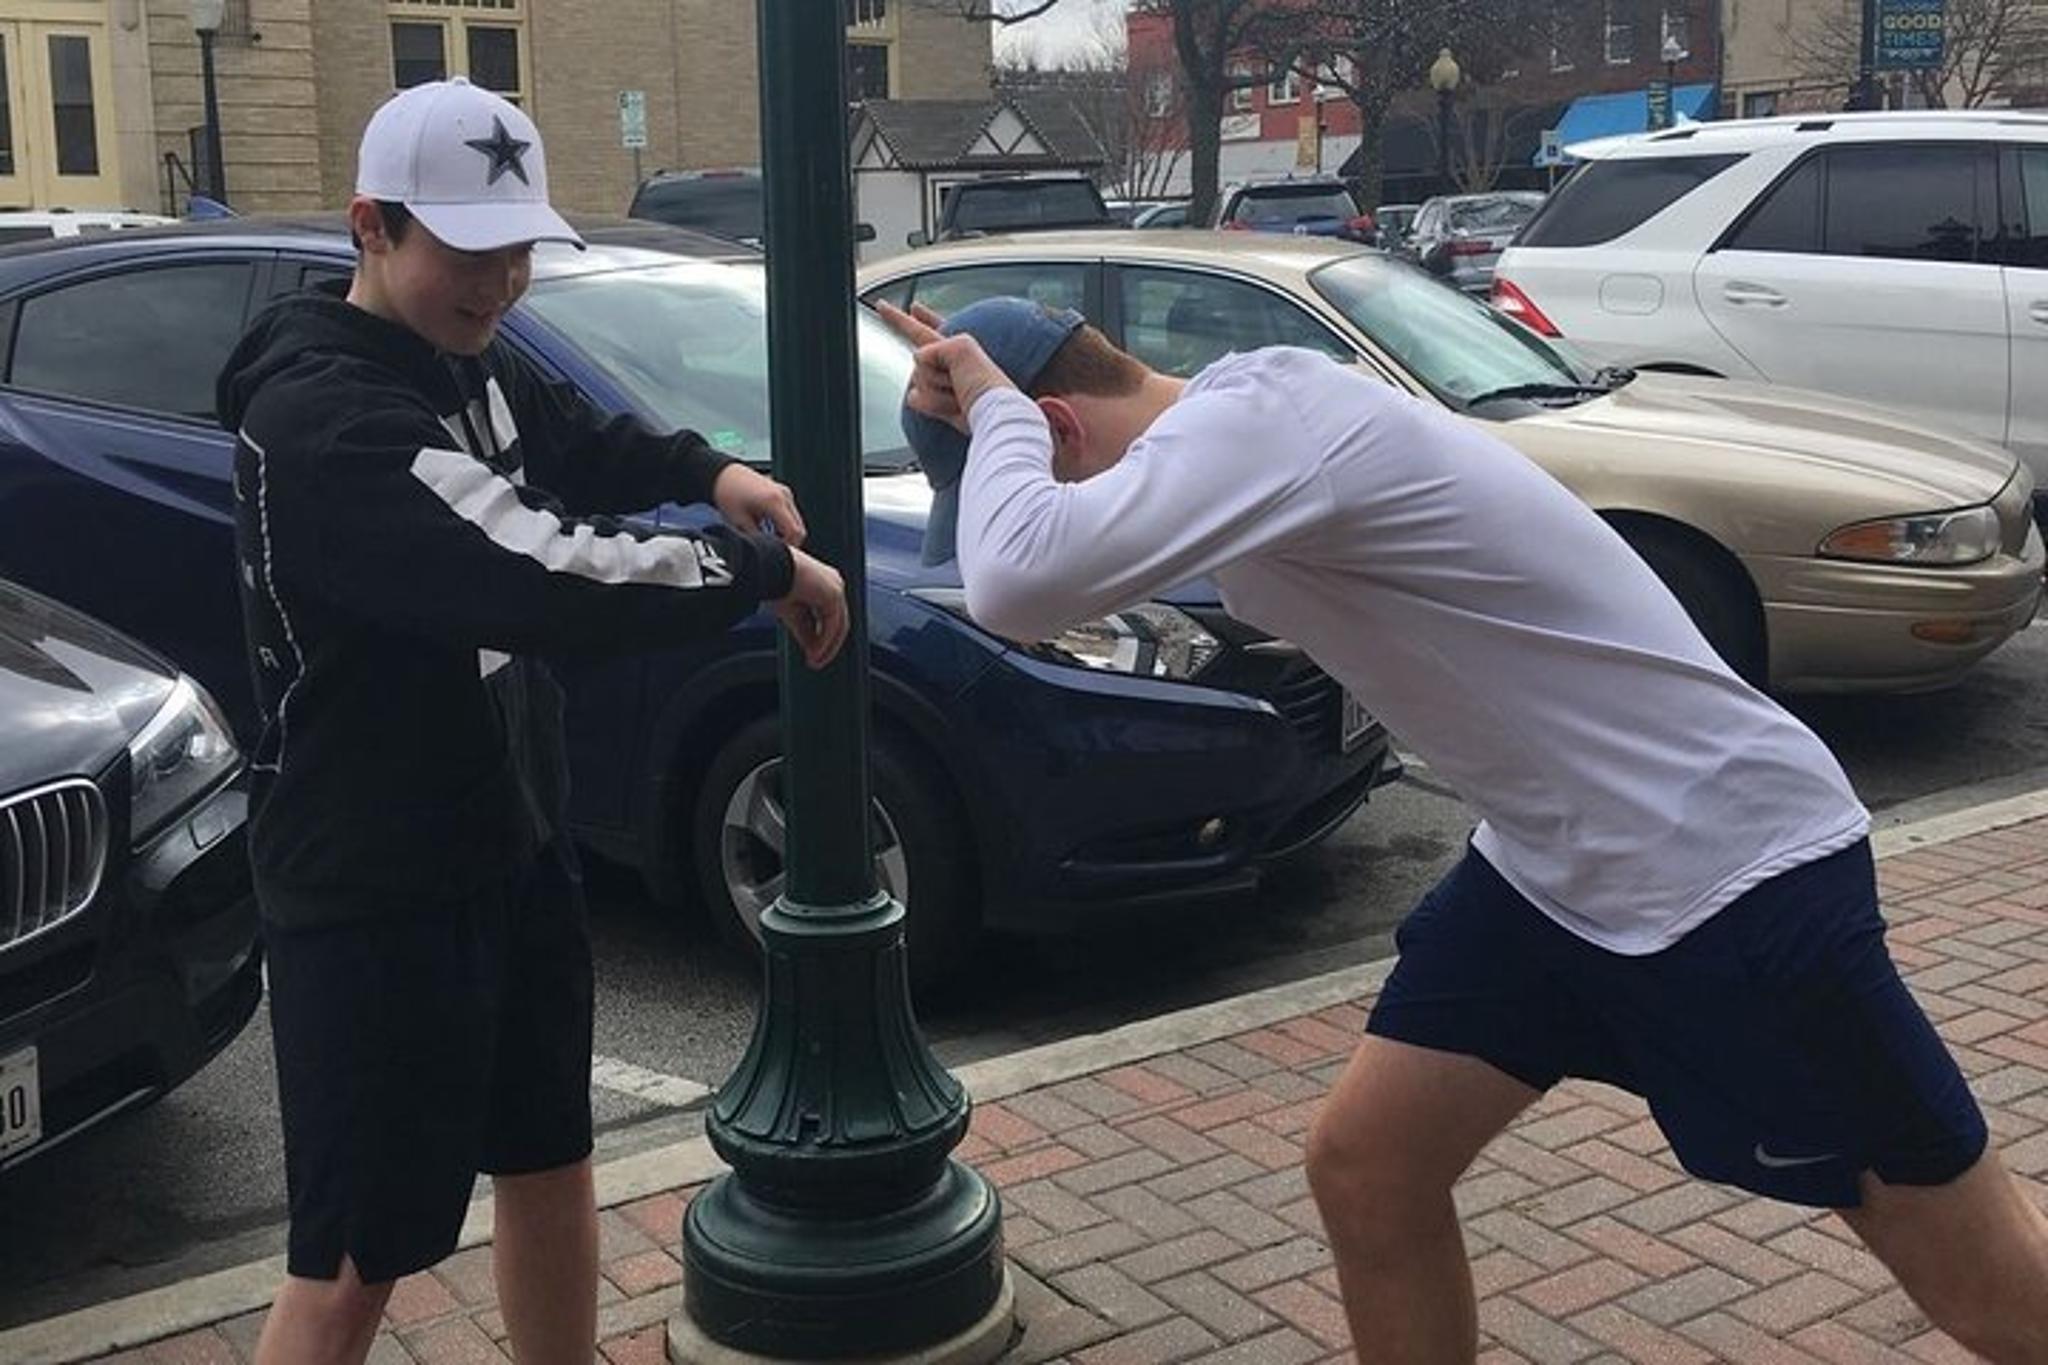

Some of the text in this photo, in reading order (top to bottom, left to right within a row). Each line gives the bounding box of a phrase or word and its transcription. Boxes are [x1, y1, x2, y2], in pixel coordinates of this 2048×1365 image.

[1883, 14, 1941, 29] GOOD
[1883, 31, 1940, 46] TIMES
[0, 1085, 26, 1137] 0
